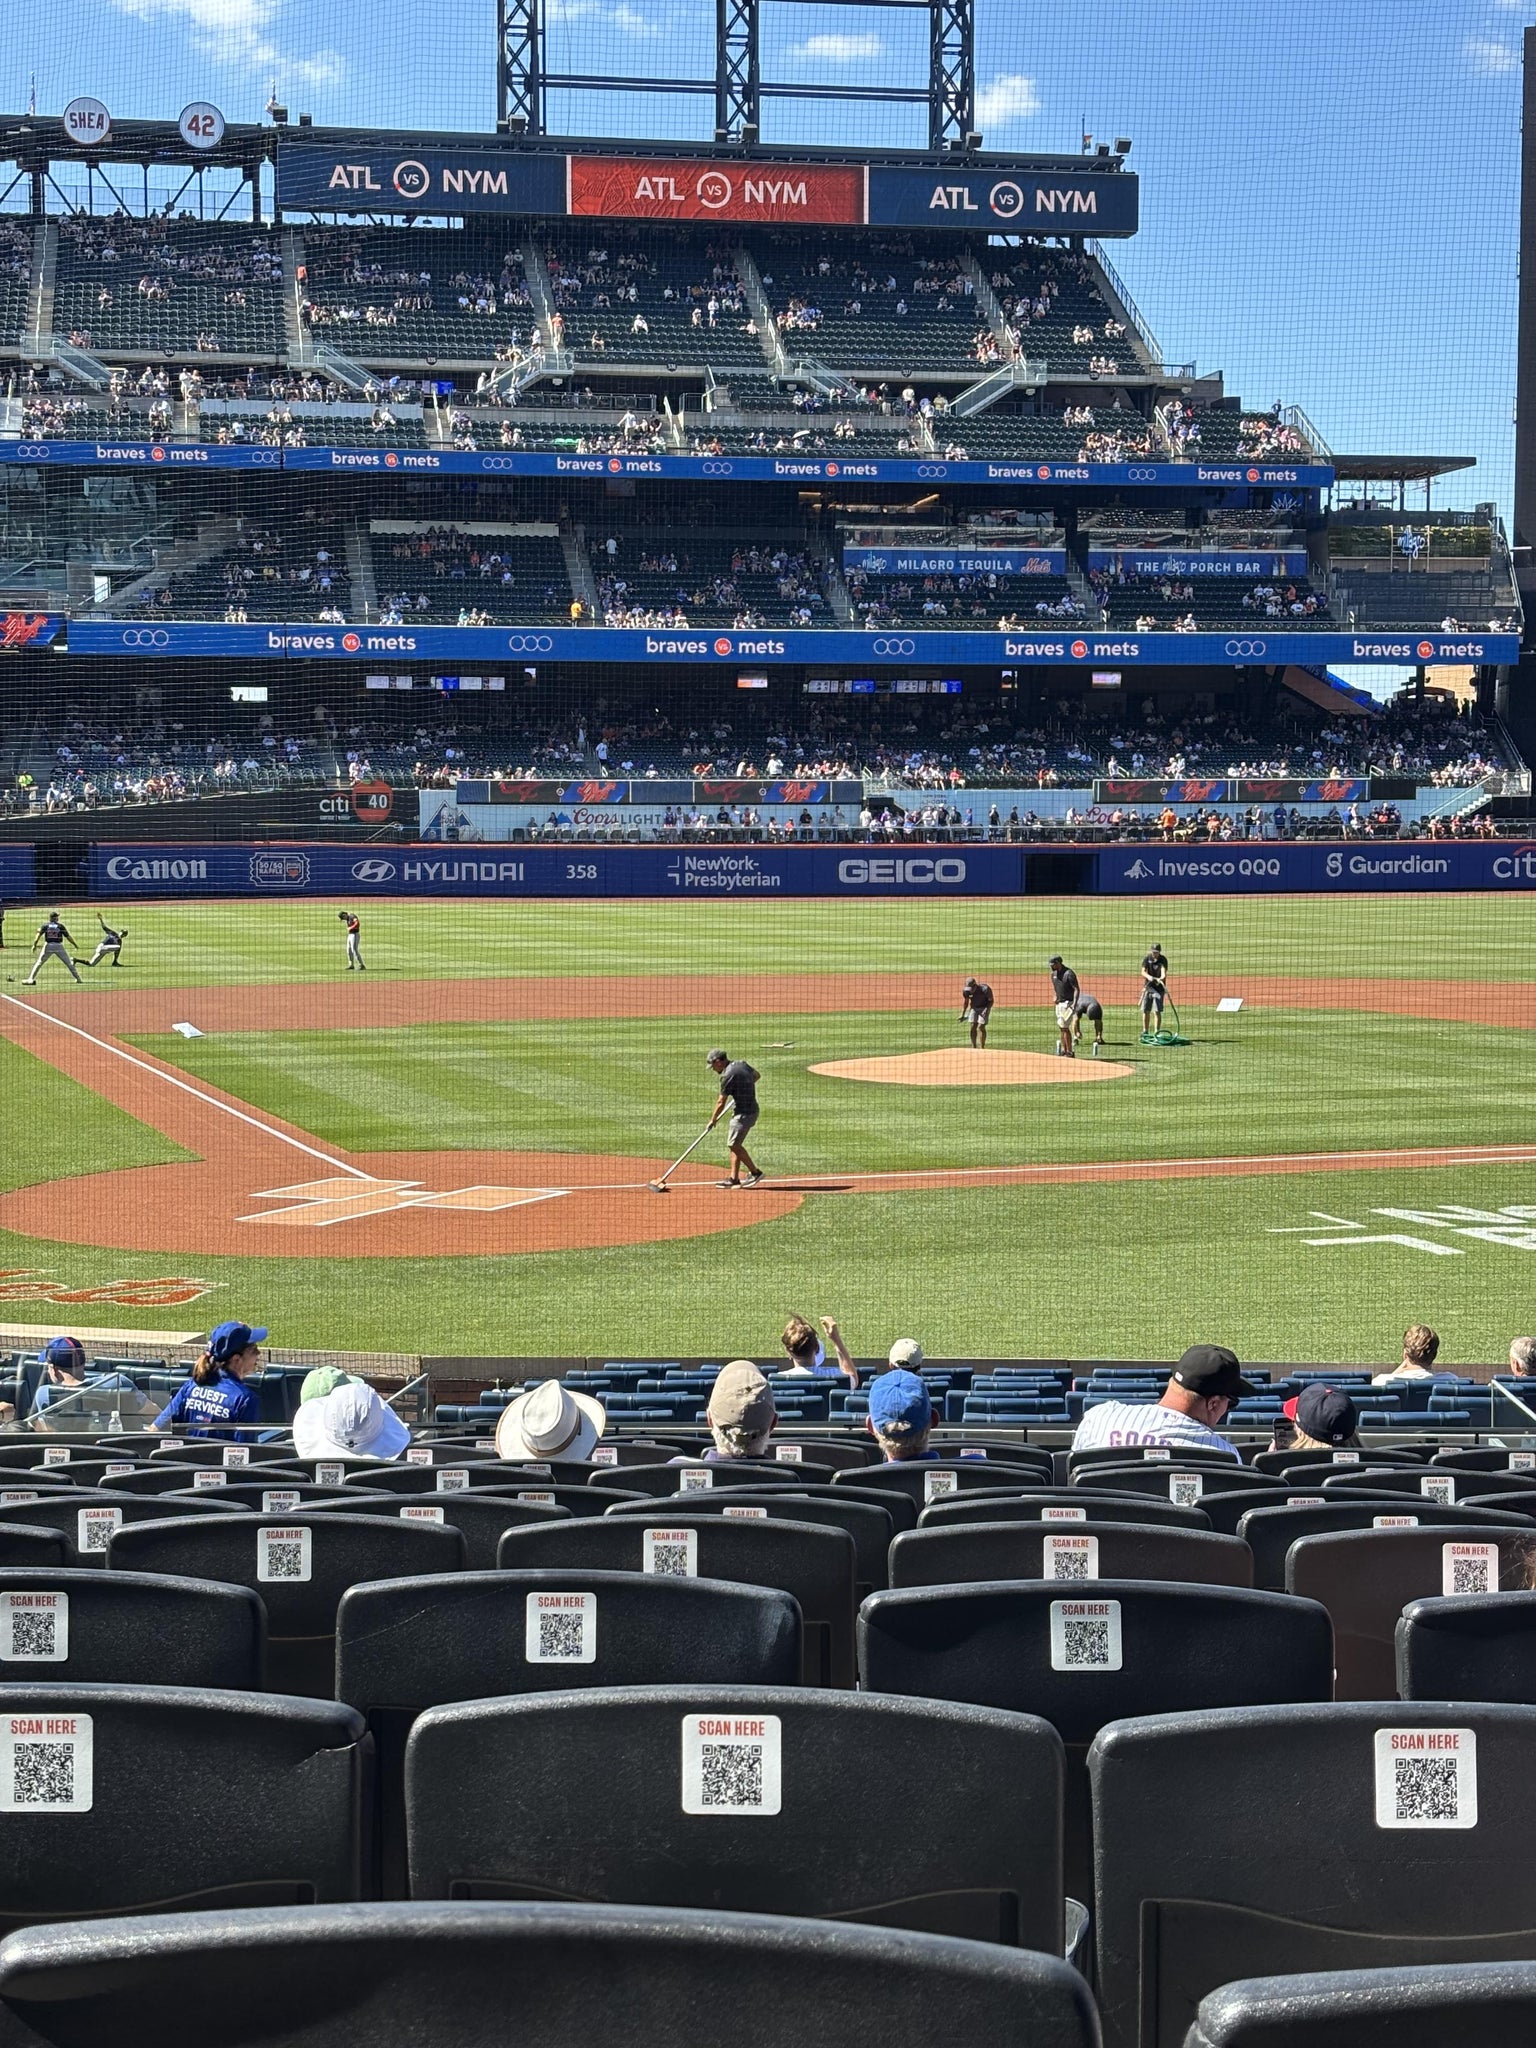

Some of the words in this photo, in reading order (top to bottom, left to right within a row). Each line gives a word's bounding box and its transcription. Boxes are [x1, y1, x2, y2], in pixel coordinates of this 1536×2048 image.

[70, 112, 105, 130] SHEA
[187, 114, 215, 136] 42
[329, 165, 381, 190] ATL
[442, 169, 508, 195] NYM
[634, 176, 685, 201] ATL
[744, 180, 807, 205] NYM
[929, 186, 979, 210] ATL
[1035, 189, 1097, 214] NYM
[97, 446, 146, 460] braves
[171, 449, 208, 461] mets
[332, 451, 380, 465] braves
[403, 455, 439, 466] mets
[557, 457, 603, 470] braves
[626, 461, 661, 471] mets
[775, 461, 820, 475] braves
[843, 465, 878, 476] mets
[988, 465, 1033, 478] braves
[1055, 468, 1089, 479] mets
[1198, 467, 1241, 480] braves
[1264, 470, 1297, 481] mets
[897, 560, 954, 570] MILAGRO
[959, 560, 1013, 571] TEQUILA
[1020, 557, 1052, 573] Mets
[1136, 562, 1159, 572] THE
[1190, 563, 1231, 572] PORCH
[1236, 563, 1261, 573] BAR
[268, 631, 334, 649] braves
[367, 635, 416, 650] mets
[646, 637, 707, 653] braves
[738, 638, 785, 654] mets
[1005, 640, 1064, 656] braves
[1094, 643, 1139, 656] mets
[1353, 640, 1411, 657] braves
[1440, 642, 1483, 656] mets
[320, 796, 349, 813] citi
[369, 794, 388, 809] 40
[573, 807, 619, 825] Coors
[621, 813, 661, 824] LIGHT
[106, 856, 207, 880] Canon
[404, 862, 524, 881] HYUNDAI
[684, 856, 759, 871] NewYork-
[839, 859, 966, 883] GEICO
[1159, 859, 1235, 876] Invesco
[1239, 858, 1281, 876] QQQ
[1349, 855, 1449, 874] Guardian
[566, 865, 597, 879] 358
[684, 871, 780, 890] Presbyterian
[191, 1386, 228, 1404] GUEST
[1049, 1510, 1063, 1518] SCAN
[1065, 1510, 1079, 1518] HERE
[266, 1530, 284, 1539] SCAN
[285, 1530, 303, 1539] HERE
[652, 1532, 669, 1541] SCAN
[671, 1532, 688, 1541] HERE
[1052, 1539, 1070, 1548] SCAN
[1072, 1539, 1089, 1548] HERE
[1451, 1546, 1470, 1555] SCAN
[1471, 1546, 1489, 1555] HERE
[10, 1596, 32, 1607] SCAN
[35, 1596, 57, 1607] HERE
[538, 1596, 560, 1607] SCAN
[563, 1596, 585, 1607] HERE
[1061, 1604, 1085, 1616] SCAN
[1087, 1604, 1110, 1616] HERE
[11, 1720, 43, 1735] SCAN
[46, 1720, 77, 1735] HERE
[698, 1720, 730, 1736] SCAN
[734, 1720, 765, 1736] HERE
[1391, 1734, 1425, 1750] SCAN
[1428, 1734, 1459, 1750] HERE
